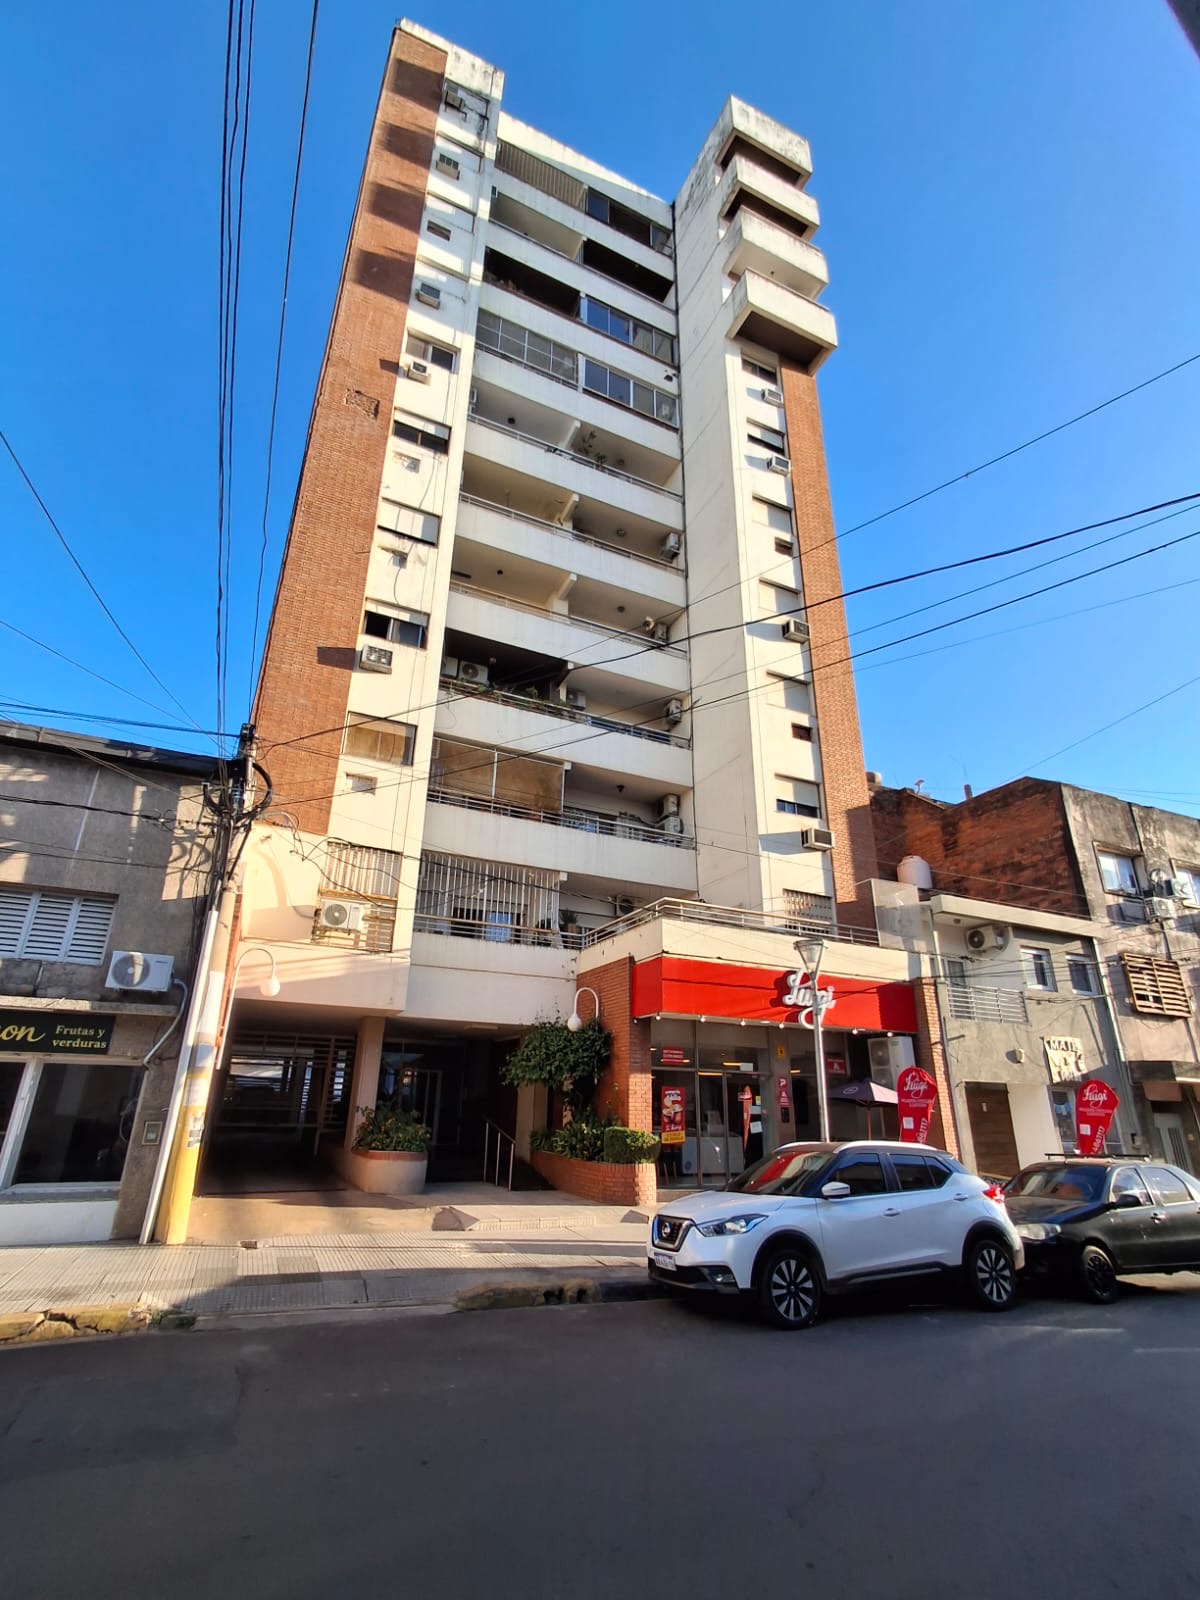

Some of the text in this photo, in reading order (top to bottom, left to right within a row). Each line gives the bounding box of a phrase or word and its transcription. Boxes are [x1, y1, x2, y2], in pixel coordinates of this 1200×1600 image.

[0, 1024, 46, 1042] on
[55, 1024, 105, 1039] Frutas y
[52, 1038, 107, 1049] verduras
[1082, 1083, 1108, 1109] Luigi
